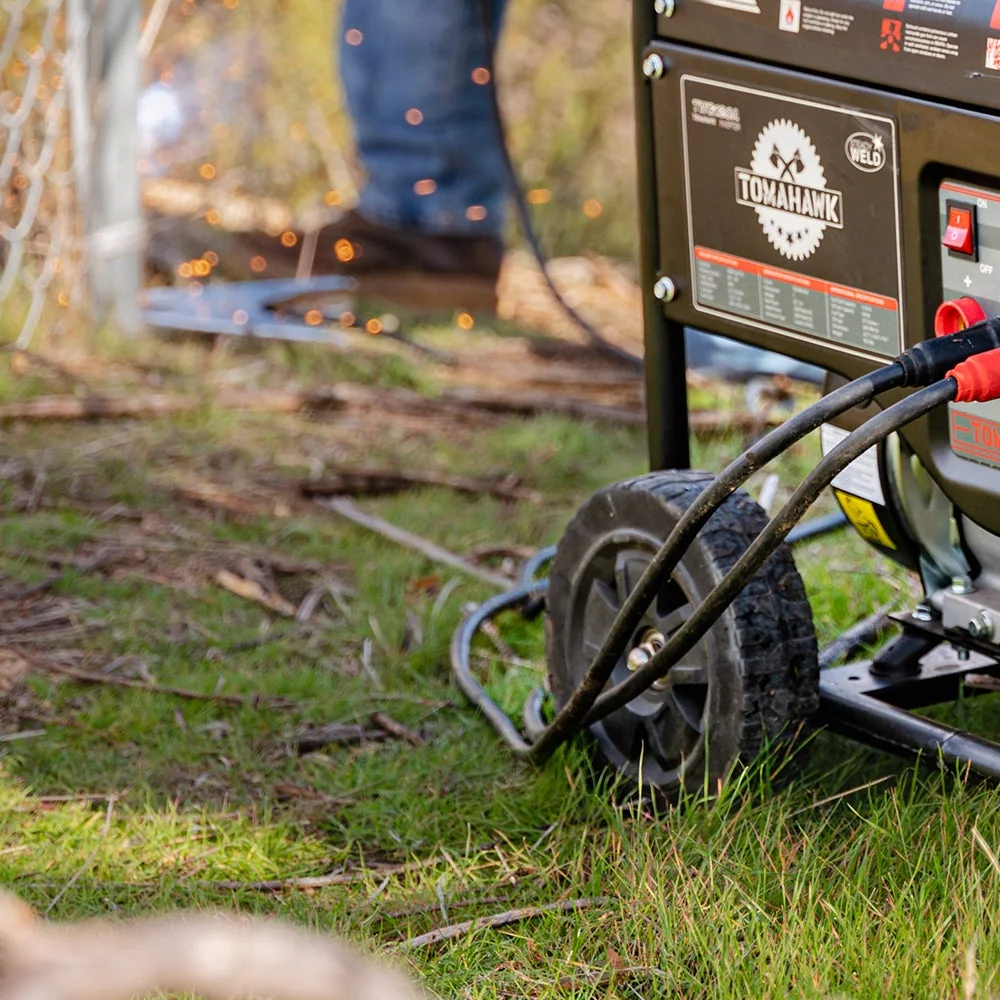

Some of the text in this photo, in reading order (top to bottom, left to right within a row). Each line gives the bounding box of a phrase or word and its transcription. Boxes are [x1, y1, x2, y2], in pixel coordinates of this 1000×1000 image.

[850, 147, 882, 167] WELD
[738, 172, 839, 223] TOMAHAWK
[977, 198, 988, 209] ON
[979, 263, 993, 275] OFF
